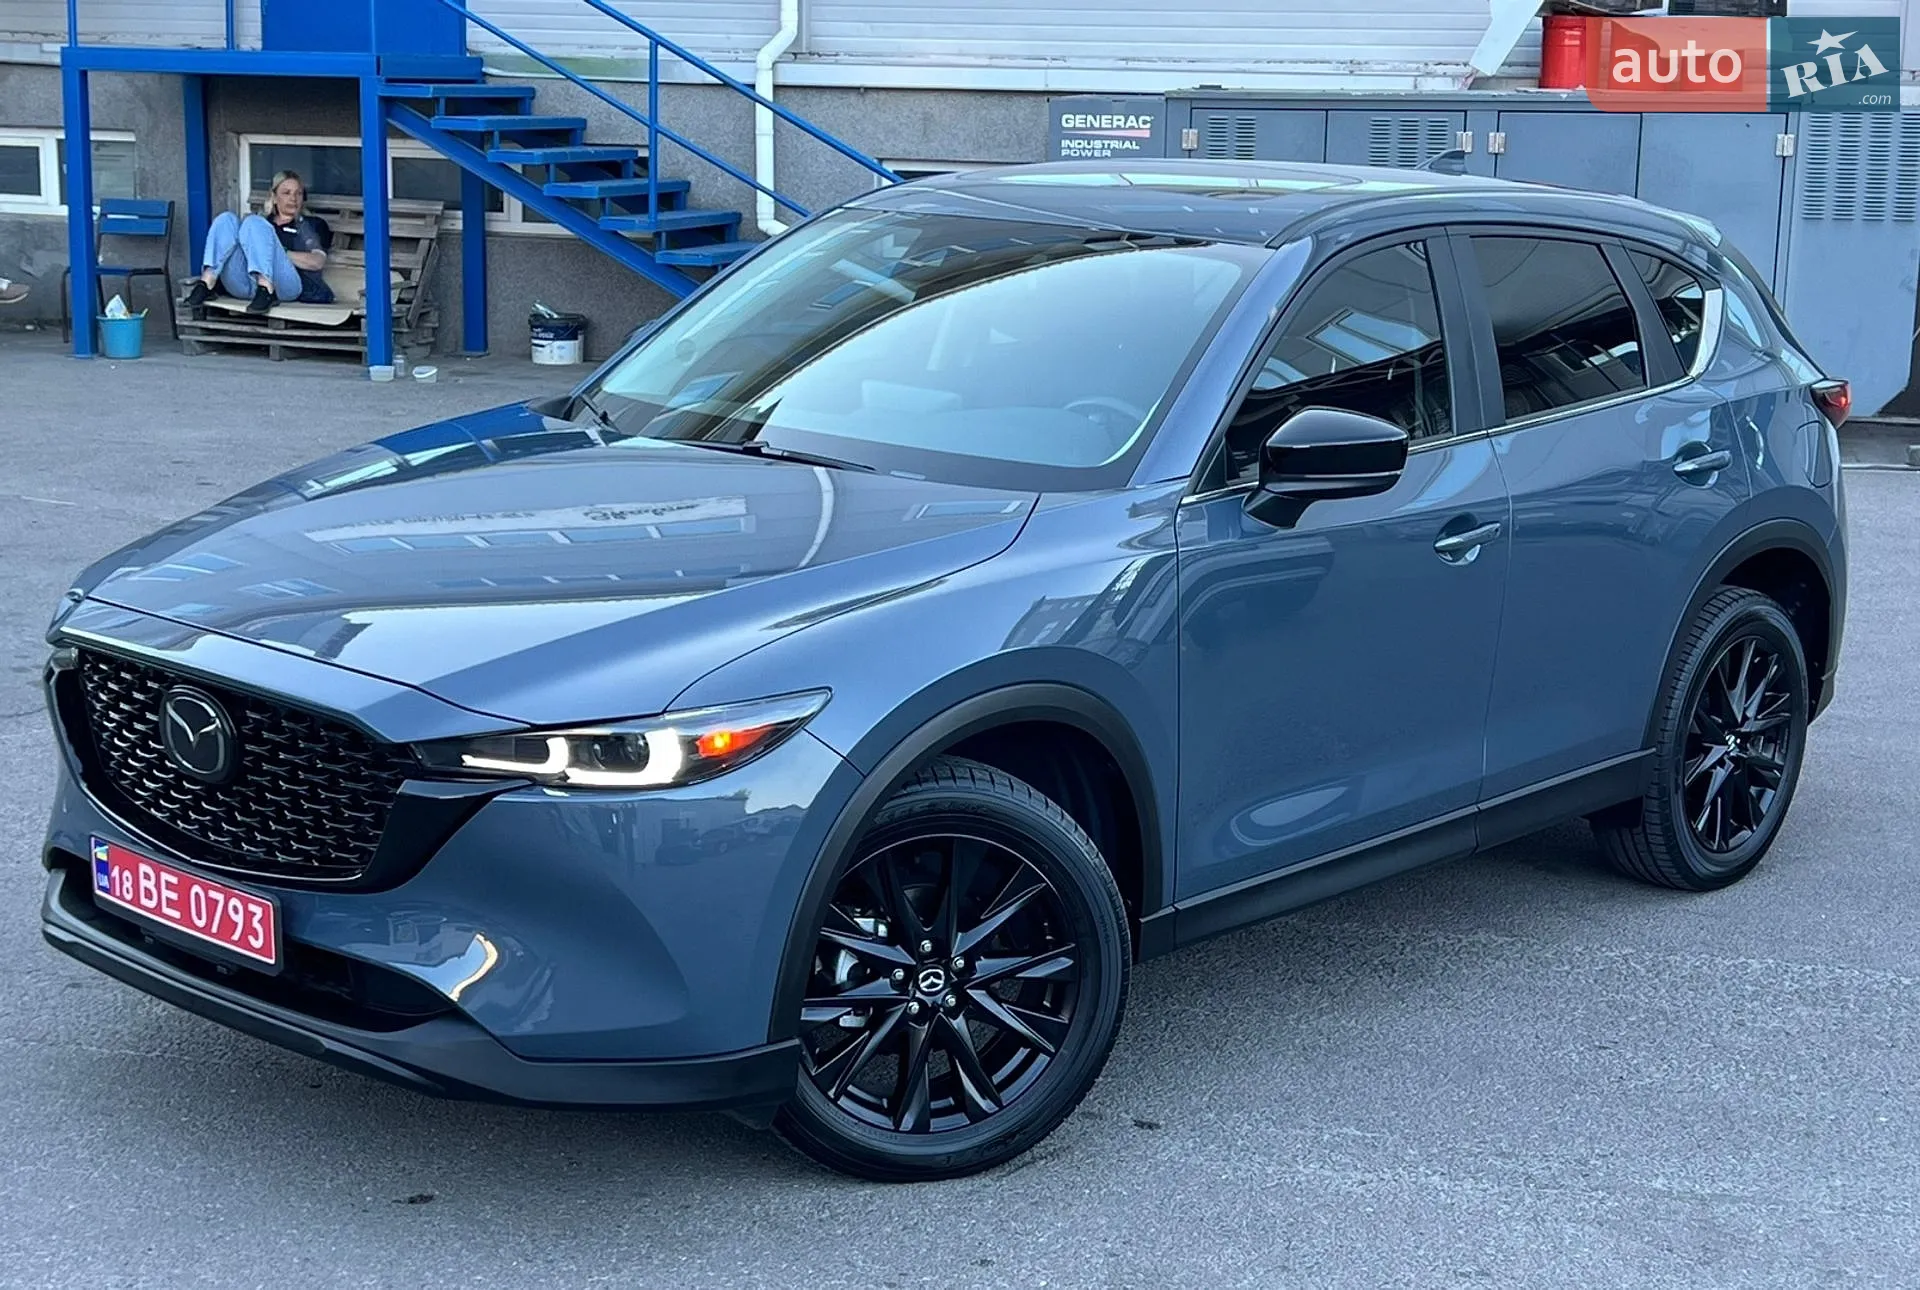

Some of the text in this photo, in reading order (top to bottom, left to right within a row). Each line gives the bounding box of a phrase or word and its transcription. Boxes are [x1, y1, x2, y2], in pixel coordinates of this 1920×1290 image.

[1062, 114, 1151, 128] GENERAC
[1061, 139, 1140, 150] INDUSTRIAL
[1061, 149, 1112, 157] POWER
[110, 862, 264, 949] 18 BE 0793
